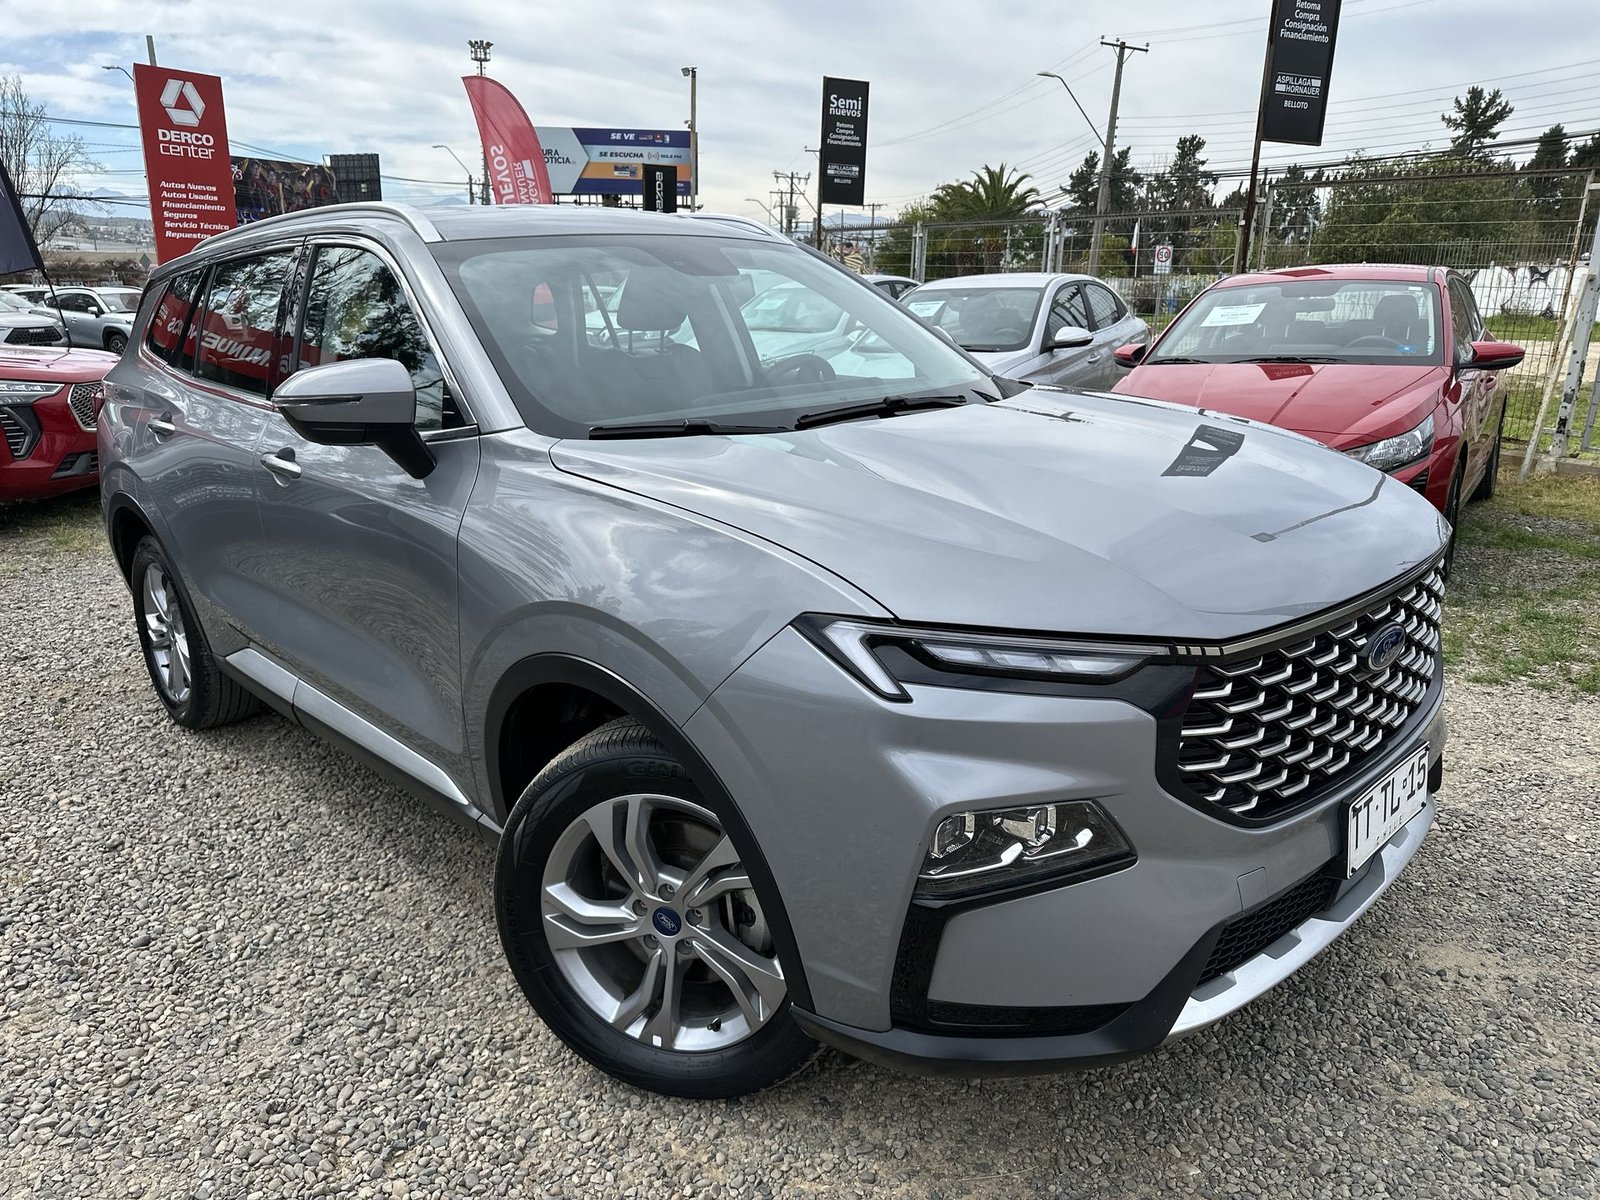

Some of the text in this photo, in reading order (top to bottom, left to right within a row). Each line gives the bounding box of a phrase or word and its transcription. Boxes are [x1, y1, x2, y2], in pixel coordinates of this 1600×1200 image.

[1296, 0, 1321, 11] Retoma
[1294, 10, 1320, 22] Compra
[1284, 18, 1327, 34] Consignación
[1280, 29, 1329, 43] Financiamiento
[1276, 75, 1312, 87] ASPILLAGA
[1285, 86, 1320, 95] HORNAUER
[829, 94, 862, 110] Semi
[1283, 100, 1309, 109] BELLOTO
[829, 107, 862, 118] nuevos
[836, 121, 854, 129] Retoma
[157, 128, 214, 146] DERCO
[610, 132, 622, 140] SE
[623, 133, 635, 141] VE
[827, 138, 862, 147] Financiamiento
[159, 143, 215, 160] center
[609, 151, 644, 159] ESCUCHA
[160, 181, 217, 192] Autos Nuevos
[161, 190, 218, 201] Autos Usados
[162, 200, 226, 211] Financiamiento
[163, 211, 198, 220] Seguros
[164, 221, 230, 231] Servicio Técnico
[165, 230, 211, 239] Repuestos
